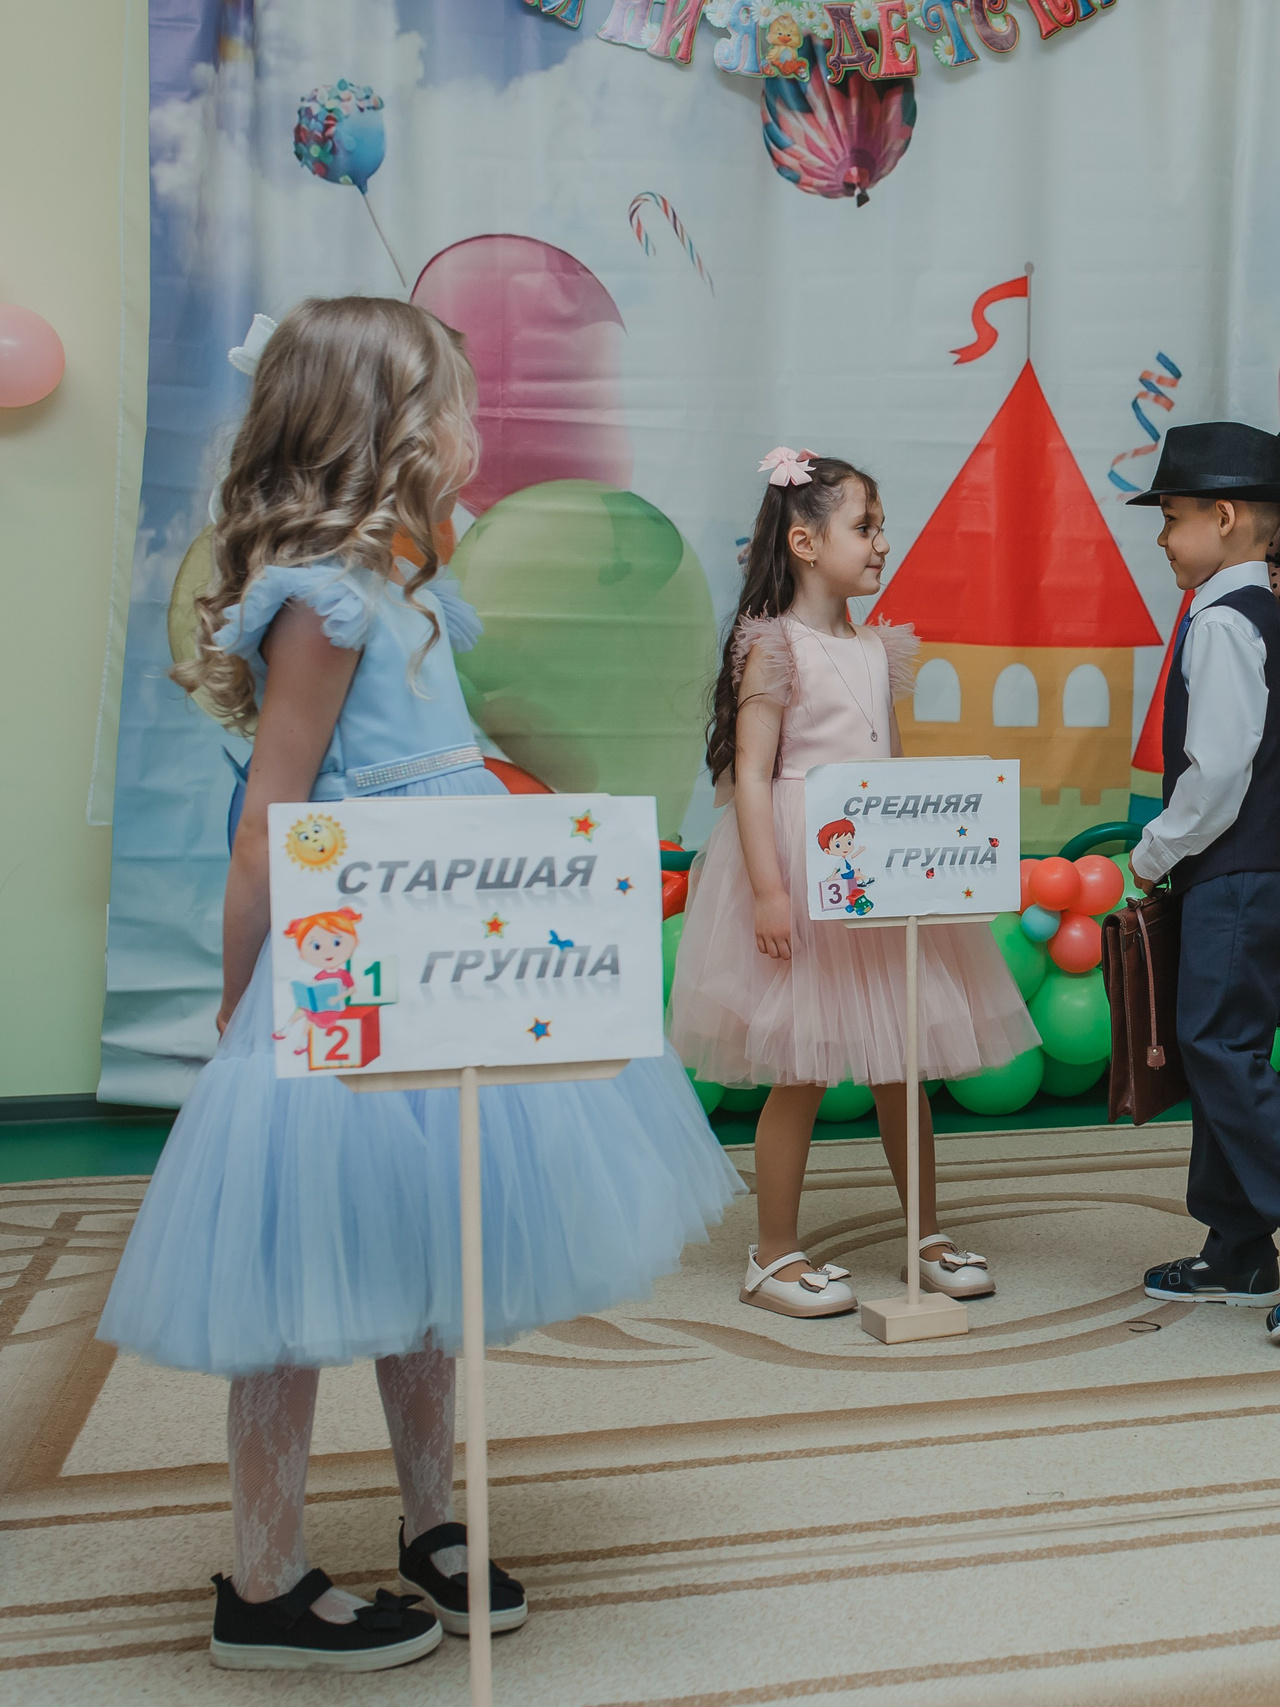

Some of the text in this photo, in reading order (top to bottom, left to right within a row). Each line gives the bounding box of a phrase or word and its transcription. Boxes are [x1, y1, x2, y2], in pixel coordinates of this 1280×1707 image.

[843, 794, 983, 819] СРЕДНЯЯ
[885, 845, 997, 868] ГРУППА
[336, 855, 598, 895] СТАРШАЯ
[828, 883, 843, 904] 3
[363, 961, 382, 997] 1
[420, 944, 621, 984] ГРУППА
[324, 1026, 350, 1061] 2
